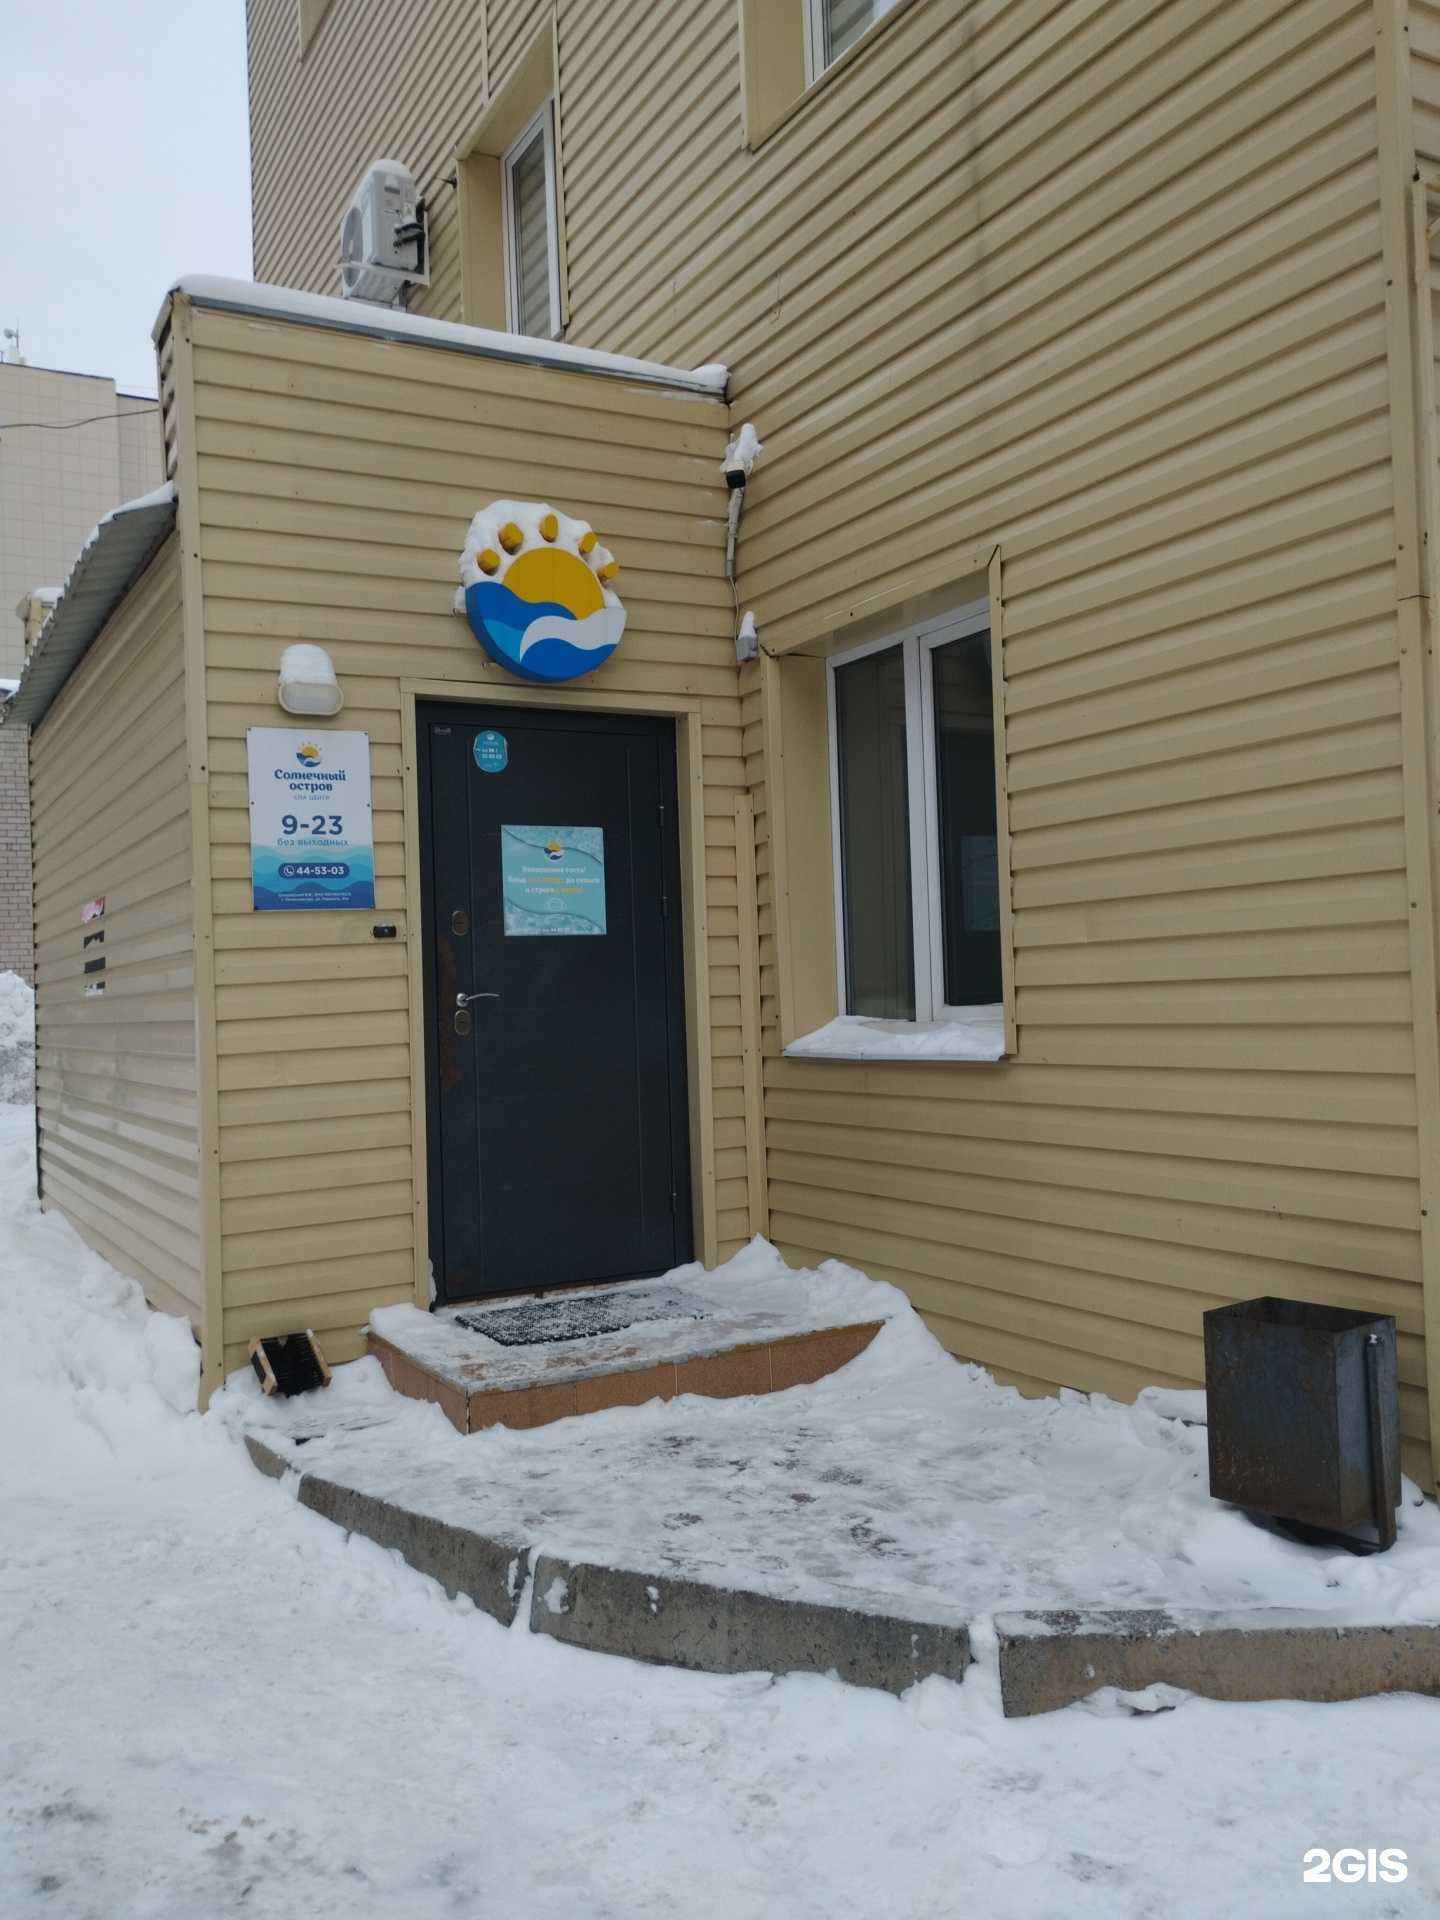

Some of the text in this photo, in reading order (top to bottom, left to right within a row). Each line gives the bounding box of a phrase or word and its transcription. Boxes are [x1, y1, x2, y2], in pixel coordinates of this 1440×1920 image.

[274, 768, 346, 781] Солнечный
[289, 782, 333, 793] остров
[281, 814, 343, 835] 9-23
[277, 838, 349, 848] без выходных
[296, 866, 345, 876] 44-53-03
